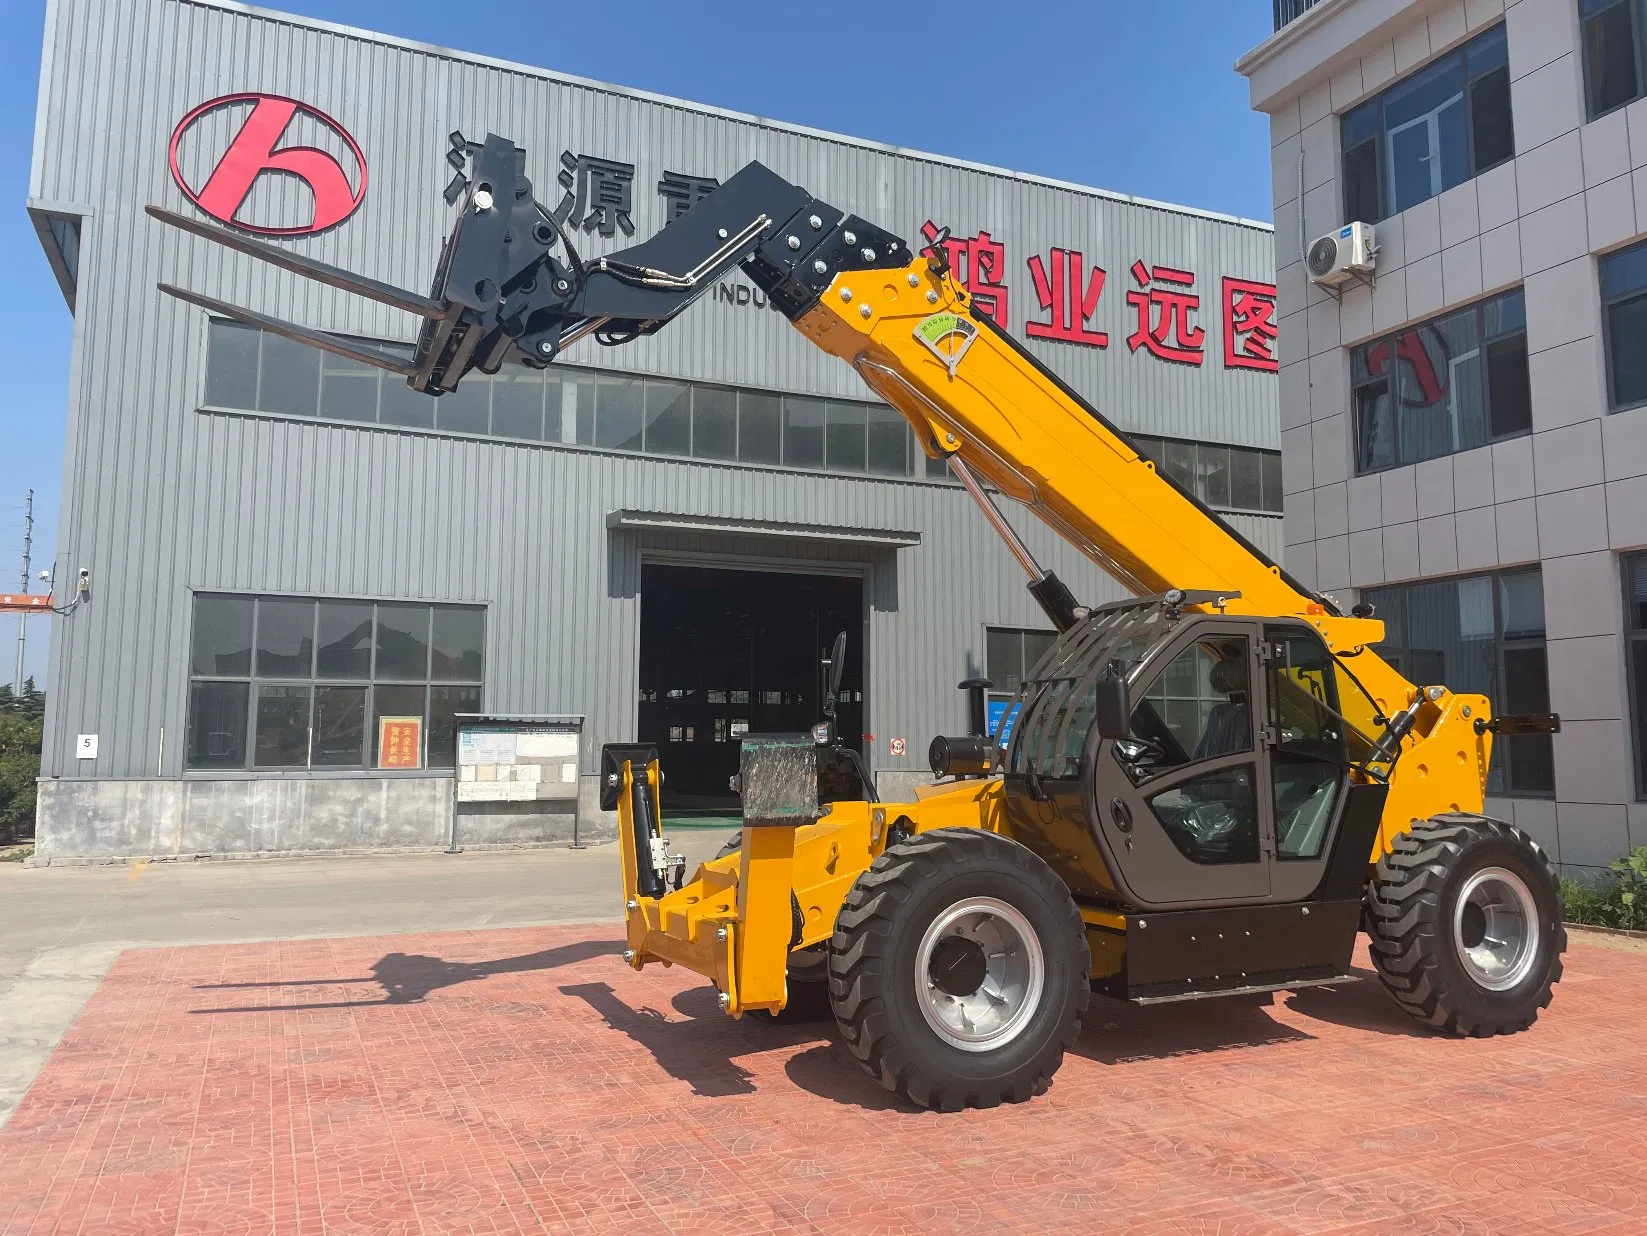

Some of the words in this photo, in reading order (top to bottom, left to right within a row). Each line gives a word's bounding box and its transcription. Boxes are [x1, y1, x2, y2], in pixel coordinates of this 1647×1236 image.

[712, 282, 779, 311] INDU
[83, 738, 91, 748] 5
[401, 726, 412, 764] 安全生产
